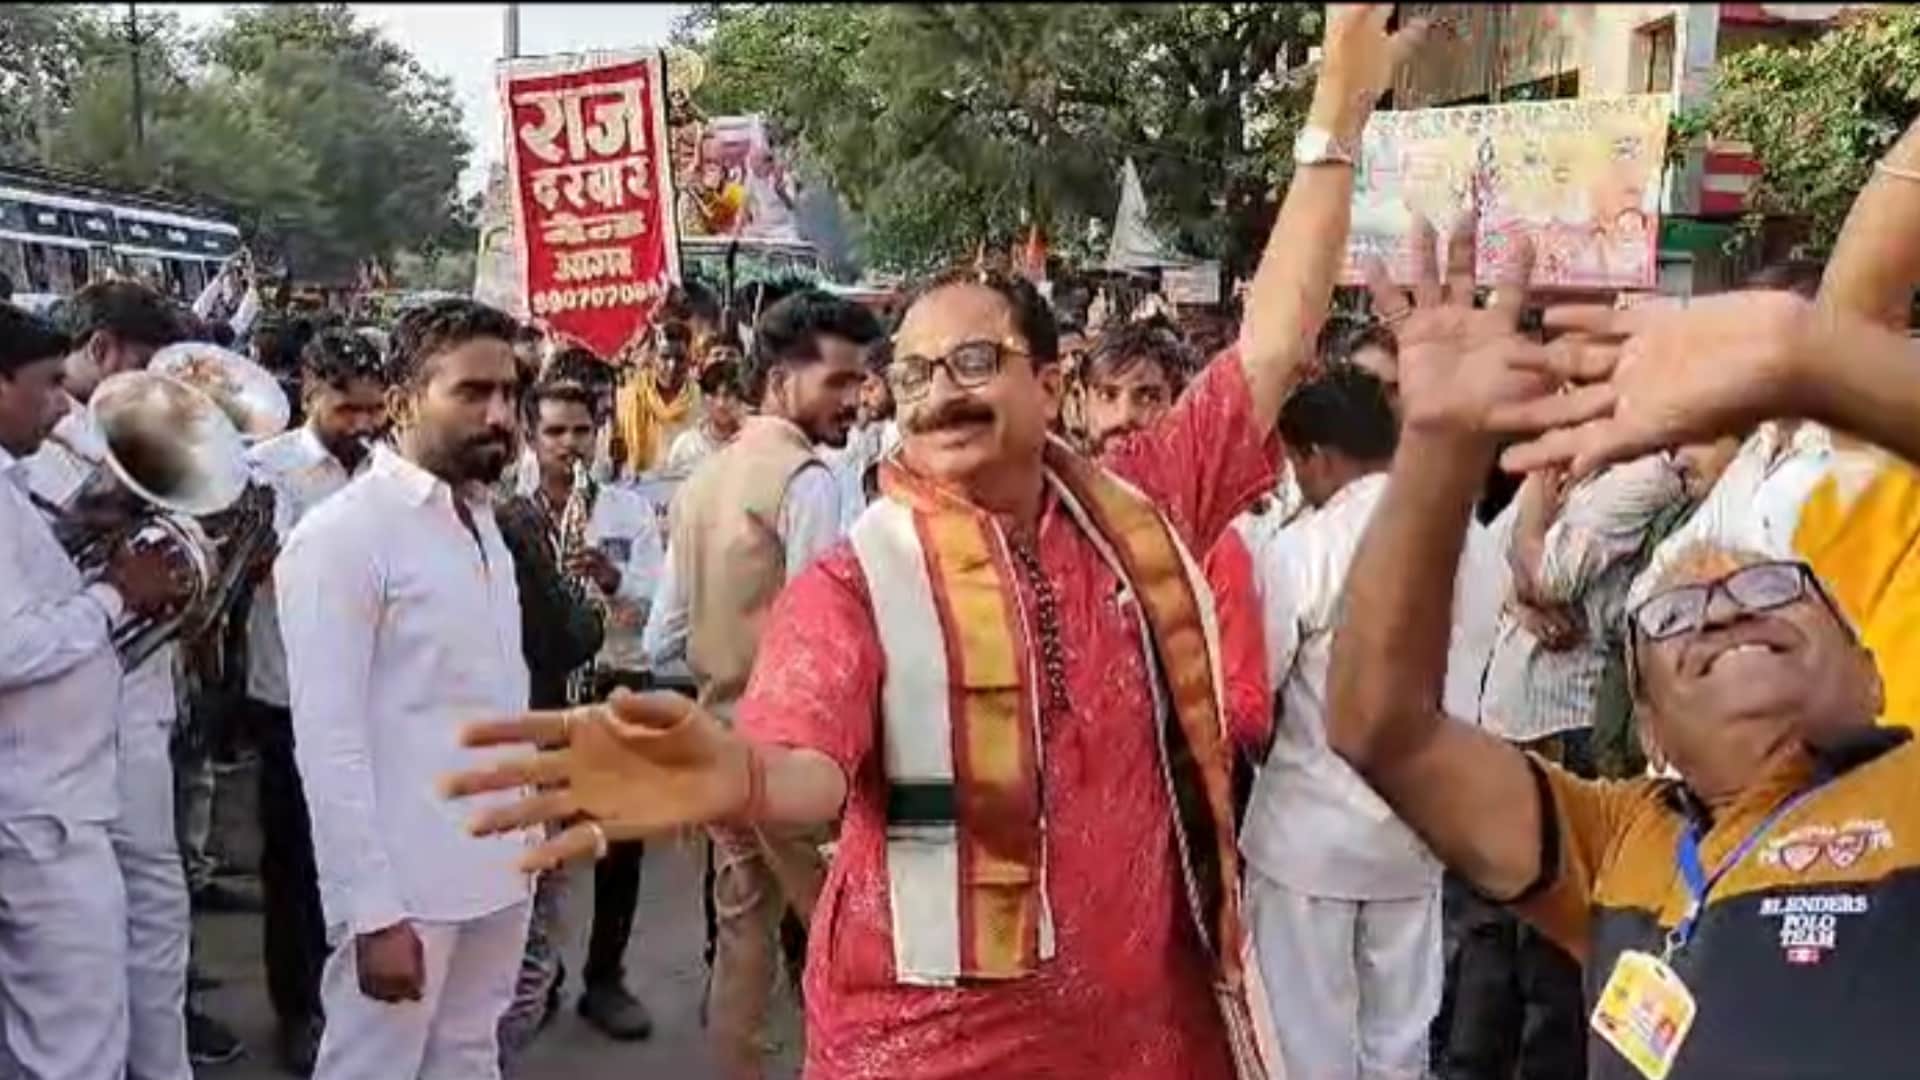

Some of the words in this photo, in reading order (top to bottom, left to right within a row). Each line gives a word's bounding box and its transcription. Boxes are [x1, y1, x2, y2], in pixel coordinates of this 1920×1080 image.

[513, 79, 646, 163] राज
[530, 156, 650, 210] दरबार
[1758, 895, 1868, 915] BLENDERS
[1783, 914, 1837, 933] POLO
[1780, 929, 1836, 949] TEAM
